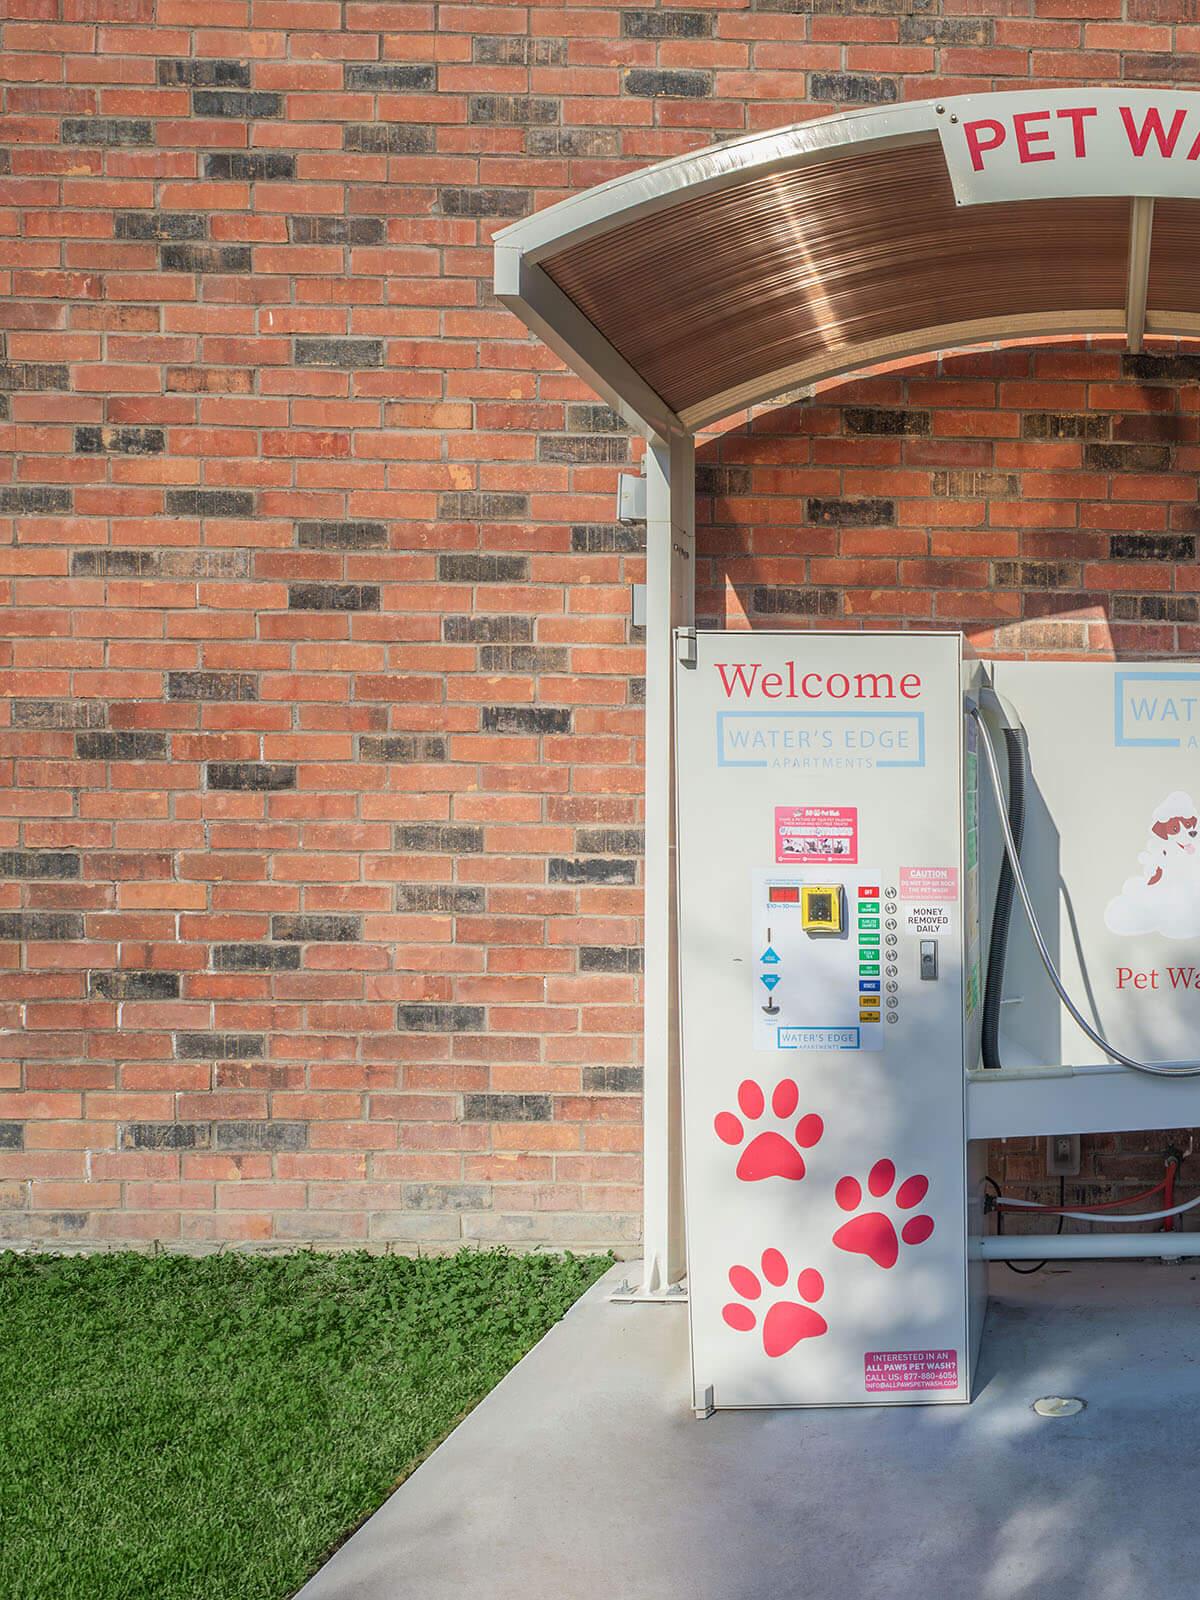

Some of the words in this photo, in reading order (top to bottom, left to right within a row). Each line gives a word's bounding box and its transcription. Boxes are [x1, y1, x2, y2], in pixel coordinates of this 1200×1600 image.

[963, 107, 1098, 172] PET
[714, 661, 921, 699] Welcome
[729, 730, 833, 749] WATER'S
[845, 730, 909, 749] EDGE
[772, 758, 873, 769] APARTMENTS
[910, 870, 947, 878] CAUTION
[913, 908, 943, 916] MONEY
[908, 916, 948, 924] REMOVED
[1116, 967, 1160, 990] Pet
[827, 1034, 854, 1042] EDGE
[884, 1363, 907, 1371] PAWS
[888, 1373, 902, 1381] US:
